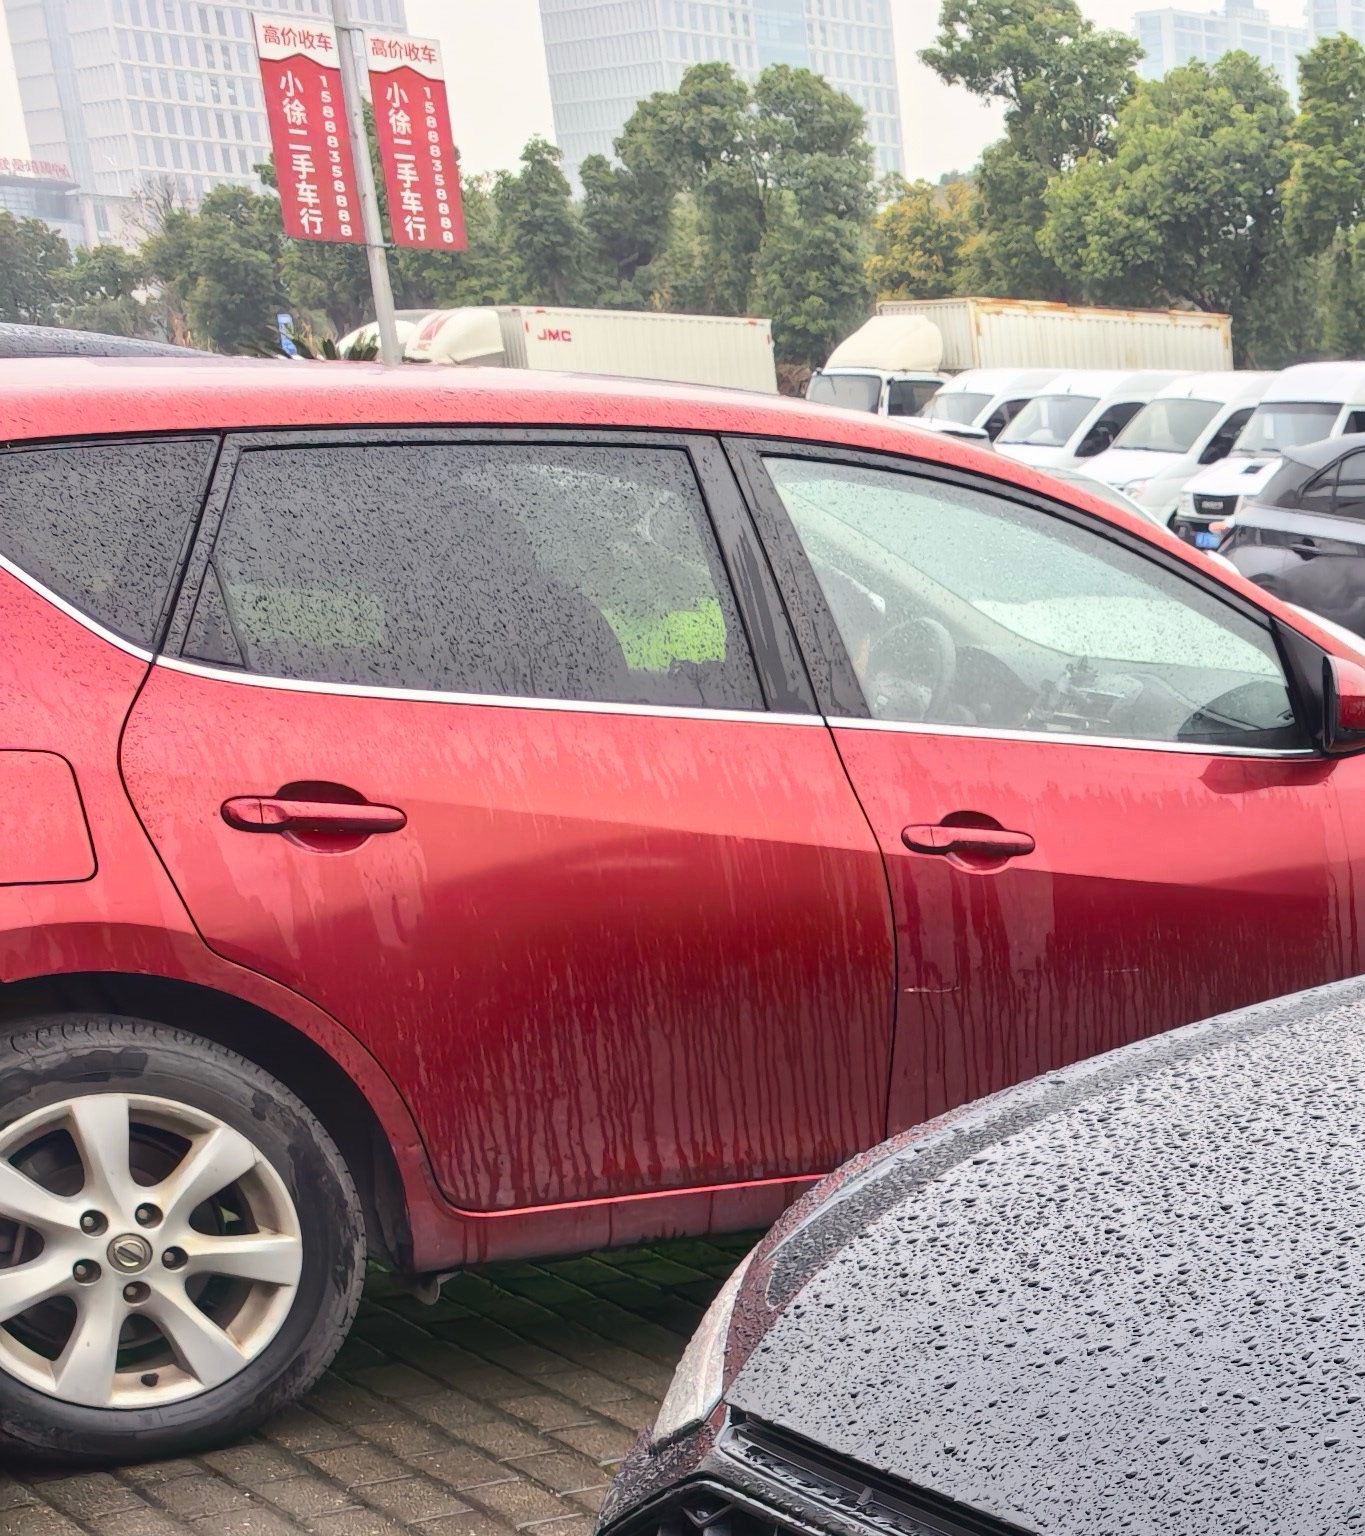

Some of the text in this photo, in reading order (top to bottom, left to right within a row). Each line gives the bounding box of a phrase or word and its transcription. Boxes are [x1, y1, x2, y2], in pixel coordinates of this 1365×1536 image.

[263, 25, 333, 52] 高价收车
[370, 38, 437, 64] 高价收车
[279, 70, 324, 235] 小徐二手车行
[319, 75, 353, 237] 15888358888
[386, 82, 427, 242] 小徐二手车行
[423, 86, 454, 244] 15888358888
[537, 328, 572, 342] JMC
